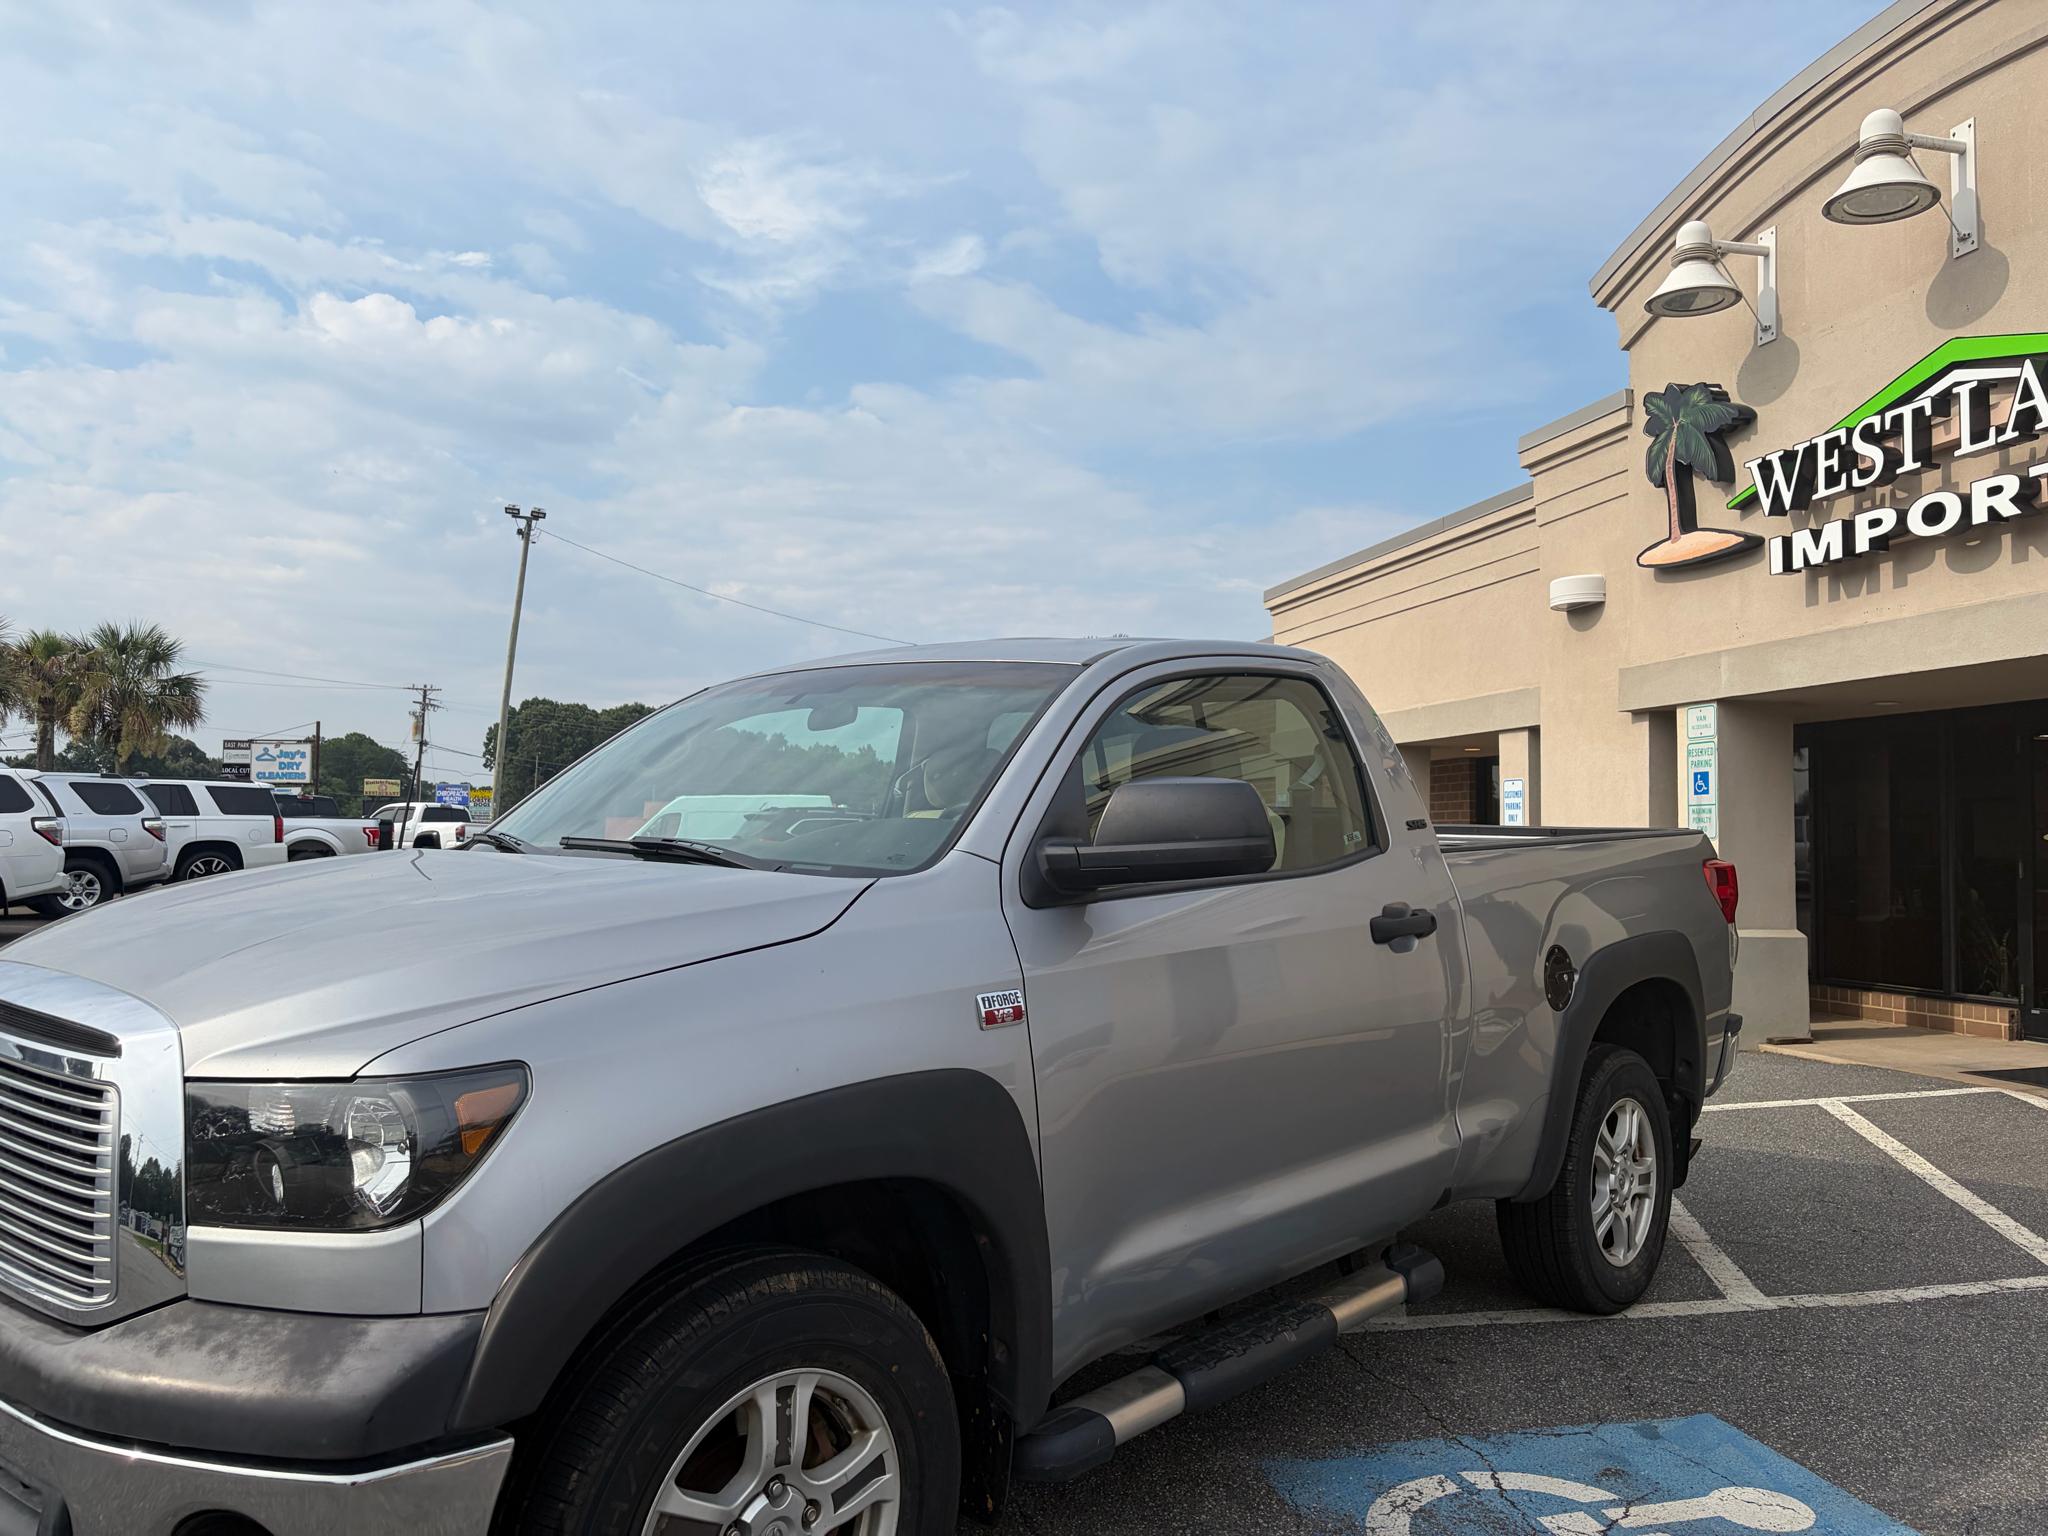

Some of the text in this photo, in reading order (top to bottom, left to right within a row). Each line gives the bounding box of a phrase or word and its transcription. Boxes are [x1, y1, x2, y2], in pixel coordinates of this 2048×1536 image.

[1744, 396, 1932, 517] WEST
[276, 749, 306, 760] Jay's
[1688, 747, 1713, 758] RESERVED
[278, 761, 302, 770] DRY
[1691, 759, 1712, 768] PARKING
[256, 771, 306, 780] CLEANERS
[1504, 790, 1521, 798] CUSTOMER
[1505, 802, 1521, 810] PARKING
[1508, 814, 1517, 822] ONLY
